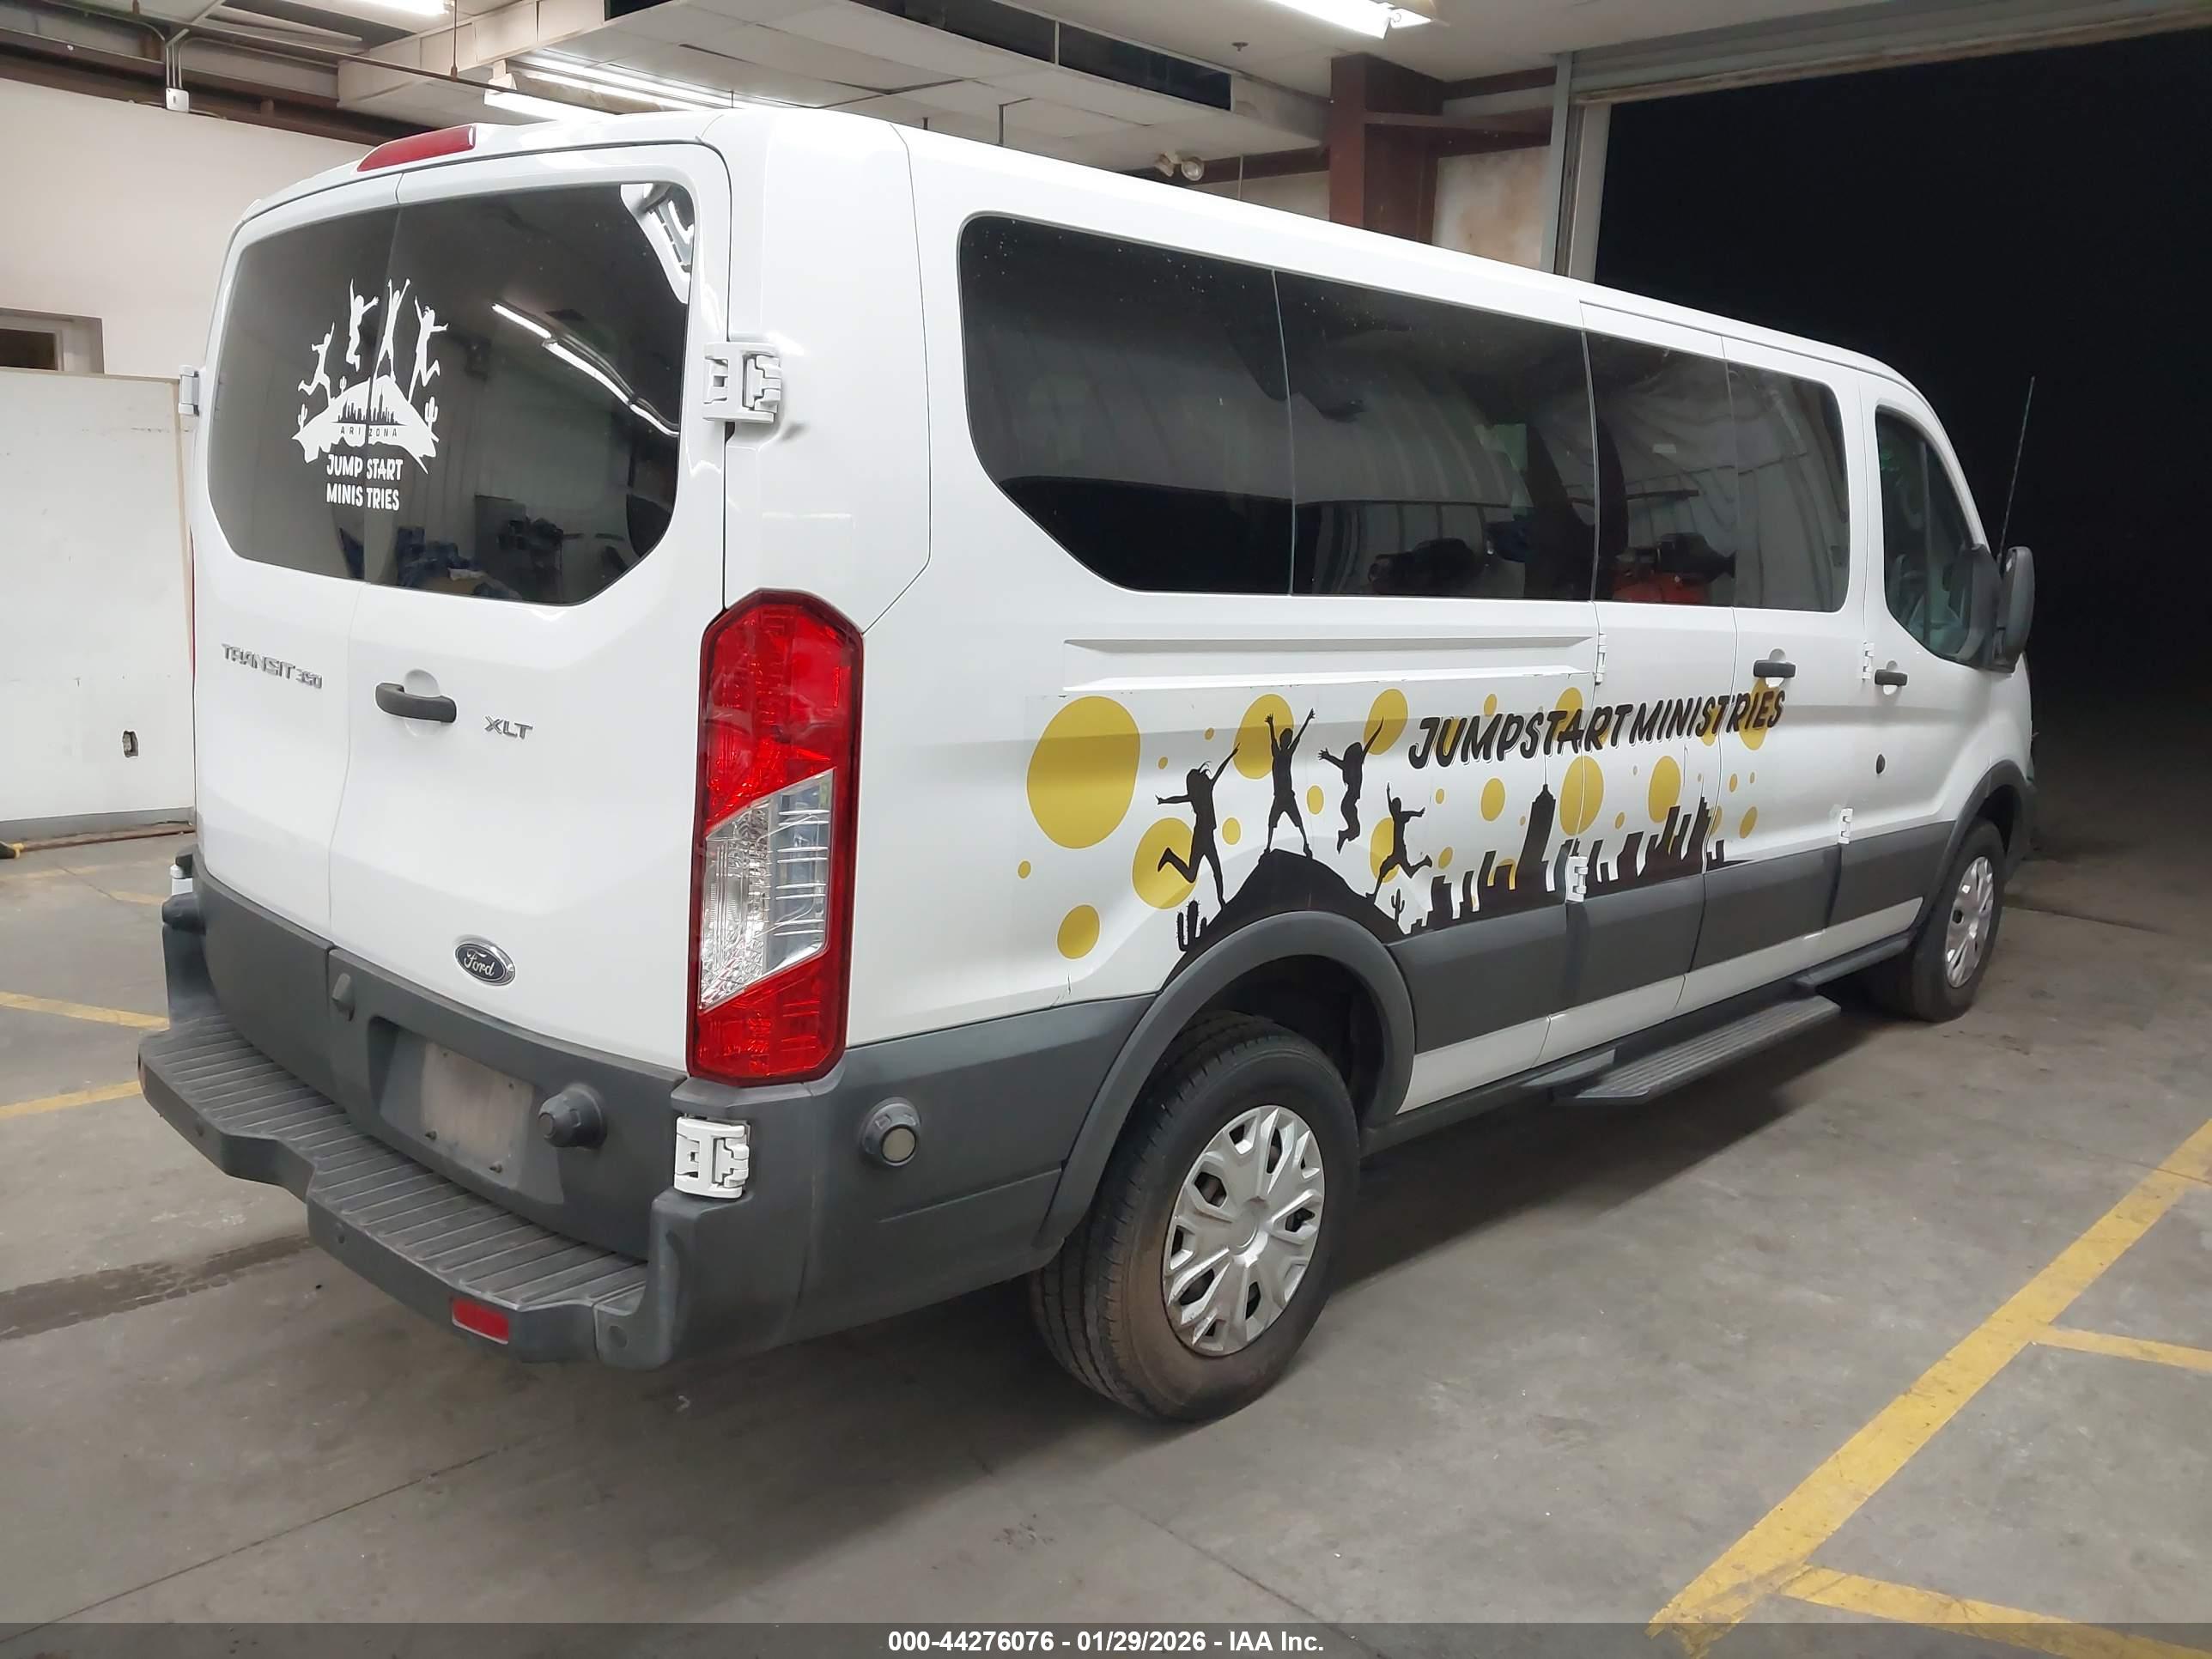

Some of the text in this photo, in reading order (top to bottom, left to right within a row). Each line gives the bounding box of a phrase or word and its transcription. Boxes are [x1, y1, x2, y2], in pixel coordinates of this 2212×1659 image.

[340, 425, 398, 438] ARIZONA
[326, 453, 404, 481] JUMP START
[222, 643, 323, 689] TRANSIT 350
[484, 715, 533, 739] XLT
[1408, 690, 1786, 769] JUMPSTART MINISTRIES
[464, 948, 495, 976] Ford
